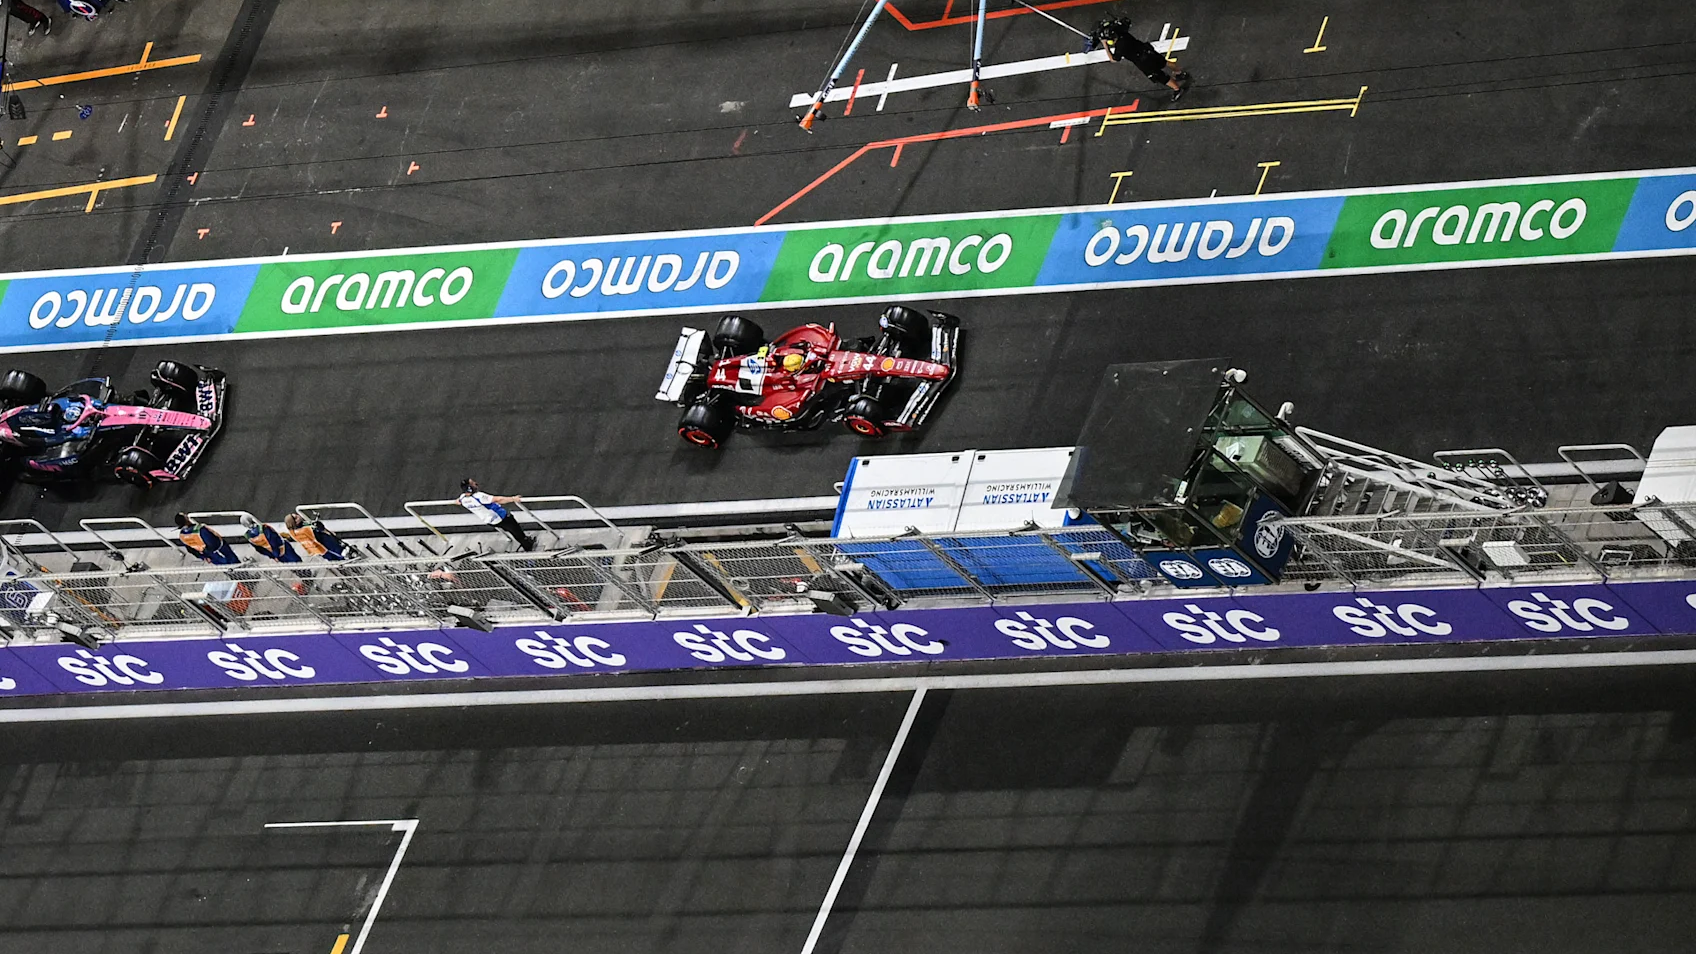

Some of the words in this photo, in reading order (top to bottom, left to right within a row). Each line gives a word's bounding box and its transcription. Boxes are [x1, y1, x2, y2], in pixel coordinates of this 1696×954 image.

[1085, 216, 1295, 267] aramco
[1370, 198, 1587, 249] aramco
[542, 251, 740, 299] aramco
[809, 234, 1012, 283] aramco
[30, 283, 216, 329] aramco
[281, 267, 473, 314] aramco
[714, 368, 726, 381] 44
[862, 355, 877, 371] 44
[867, 497, 923, 509] ATLASSIAN
[983, 492, 1038, 505] ATLASSIAN
[994, 611, 1110, 651] stc
[1163, 604, 1280, 644] stc
[1333, 598, 1453, 638] stc
[1508, 592, 1629, 633] stc
[358, 637, 469, 675] stc
[515, 631, 626, 668] stc
[673, 624, 786, 663] stc
[830, 617, 944, 657] stc
[58, 649, 164, 687] stc
[207, 643, 316, 681] stc
